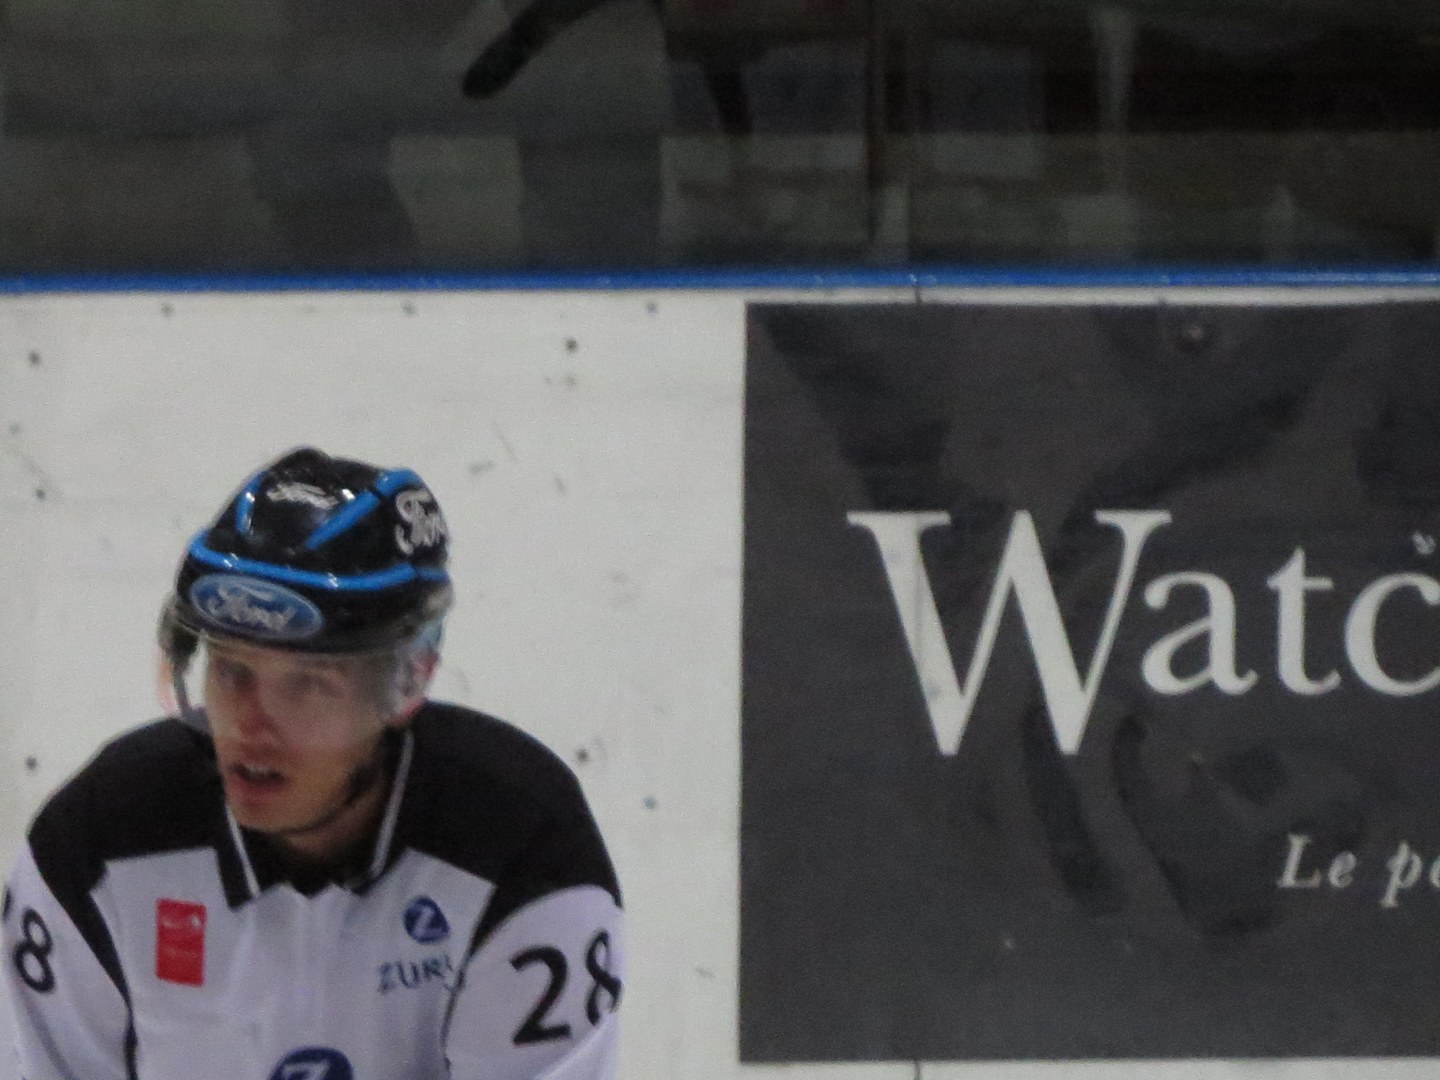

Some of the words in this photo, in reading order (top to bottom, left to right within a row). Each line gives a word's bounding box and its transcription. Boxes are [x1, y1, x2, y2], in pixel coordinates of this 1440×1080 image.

[1278, 833, 1358, 888] Le
[3, 886, 56, 993] 8
[510, 929, 622, 1046] 28
